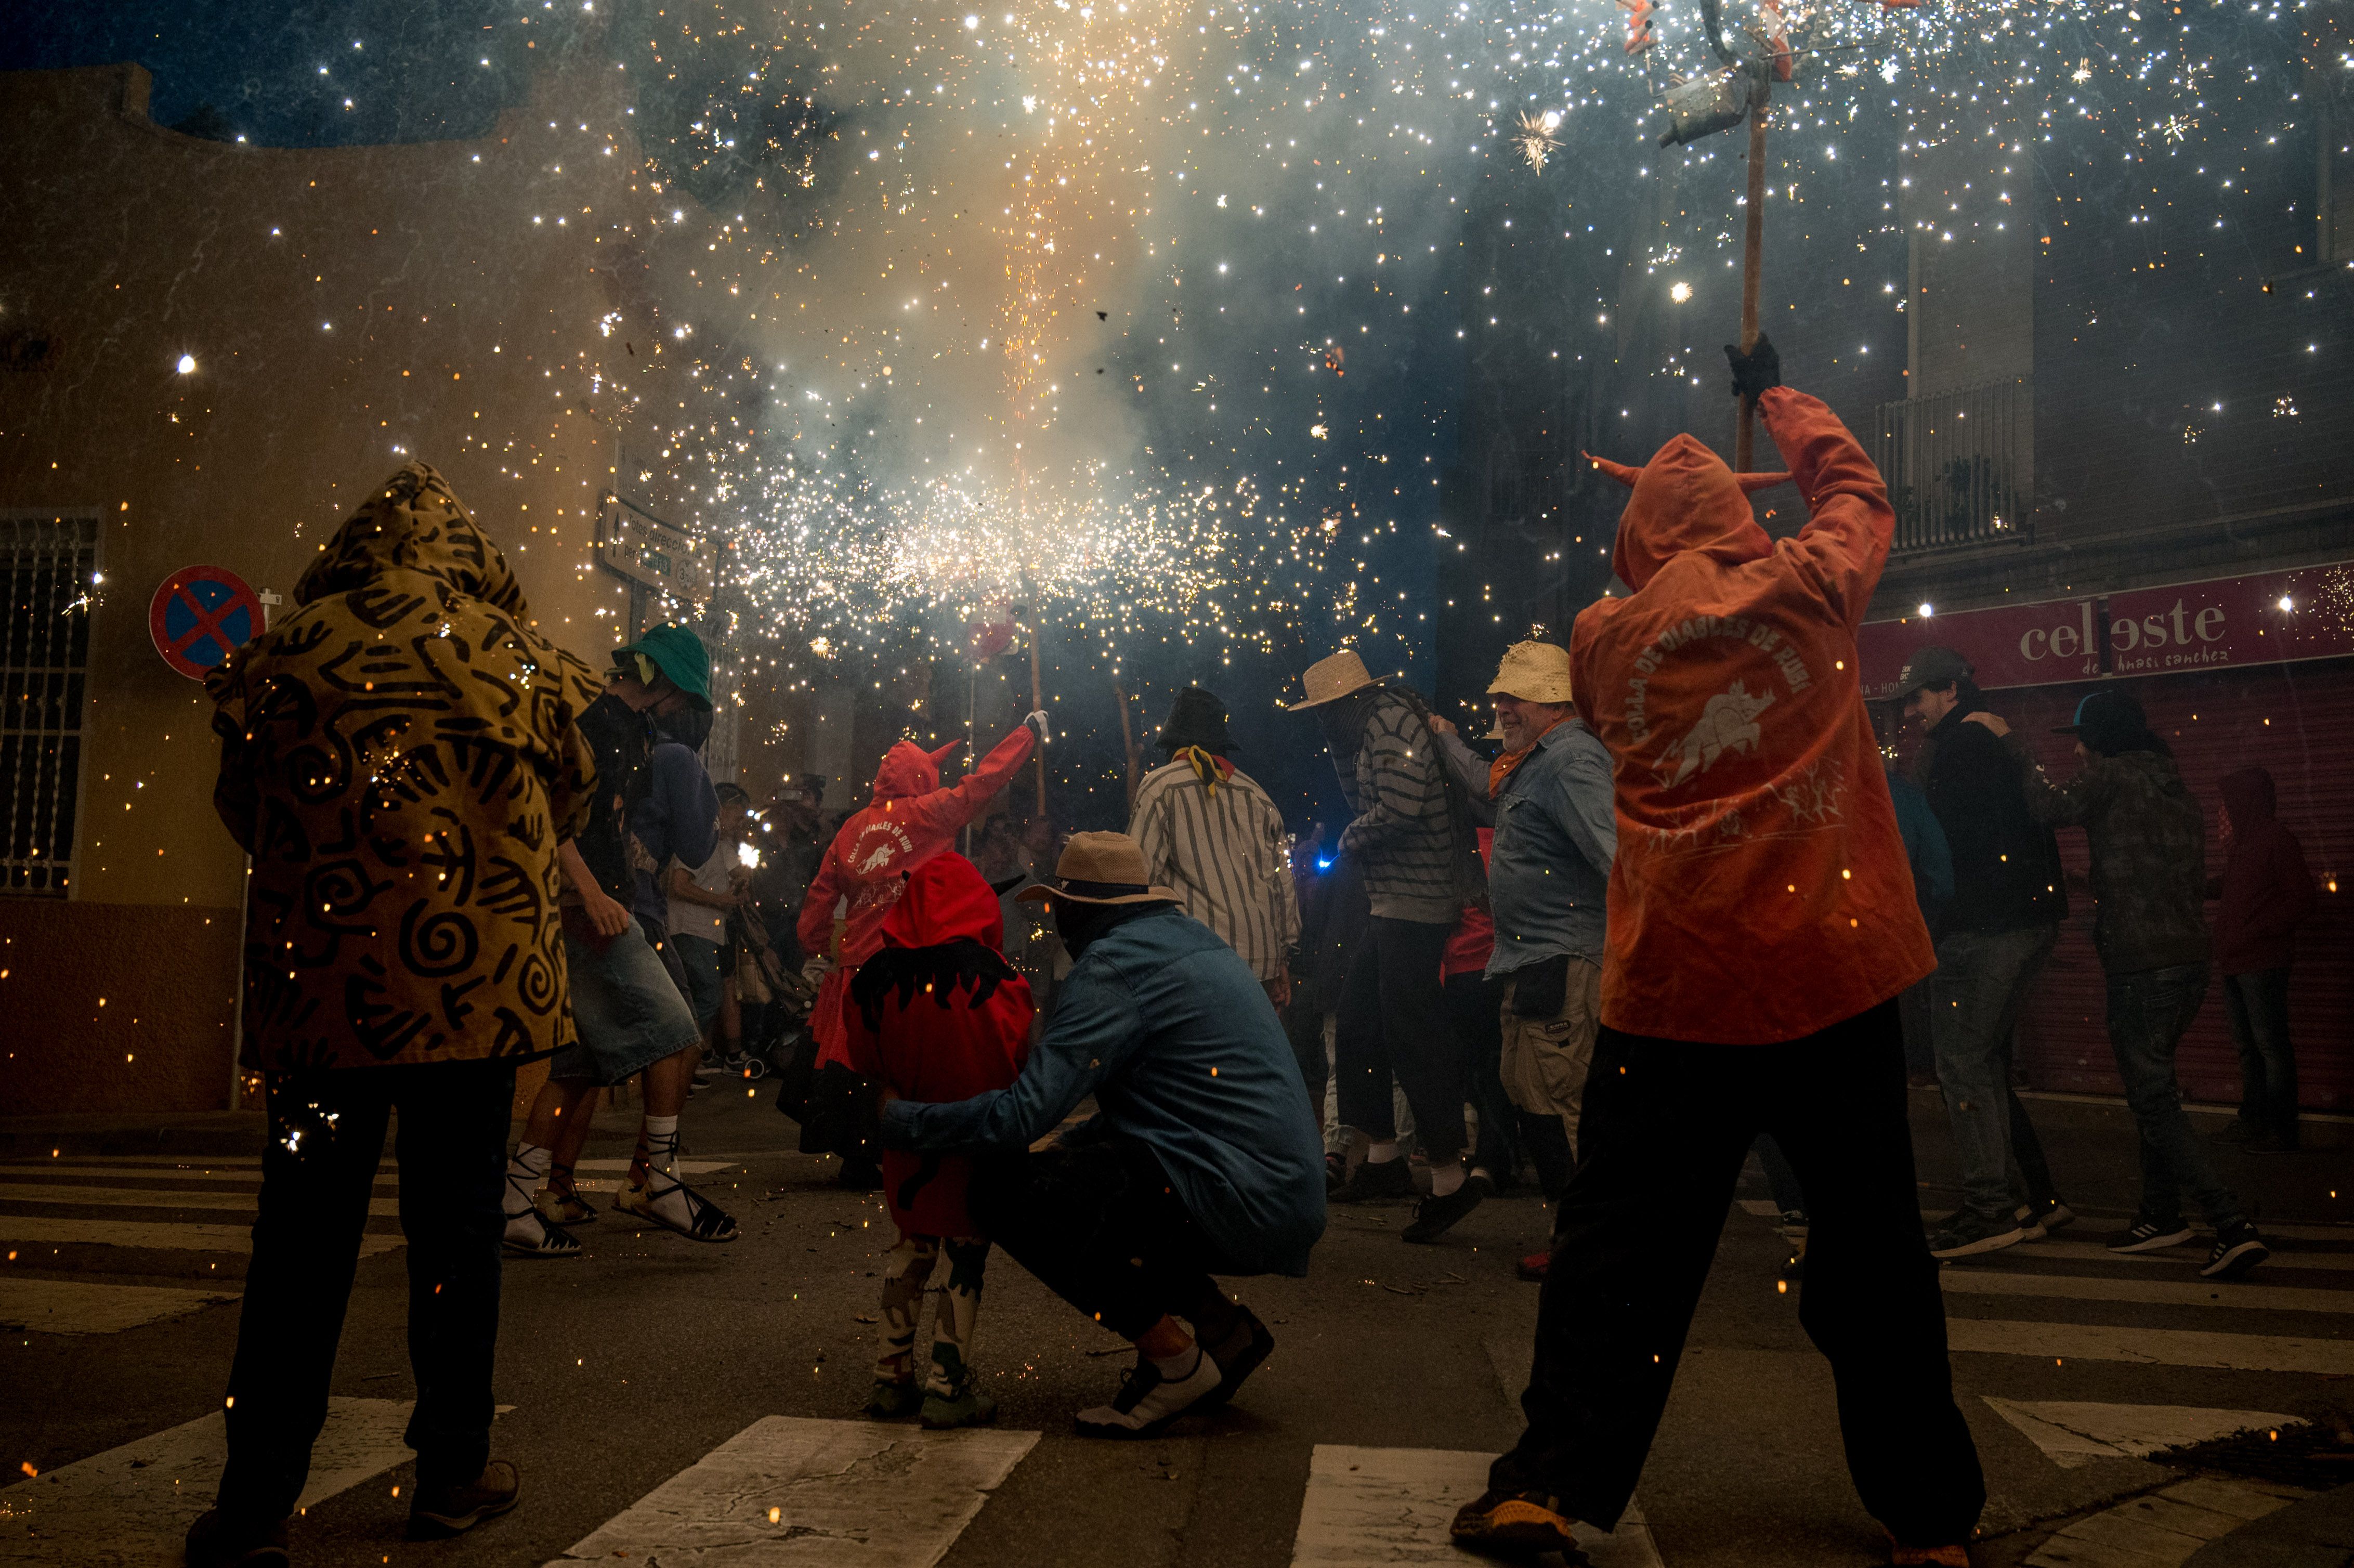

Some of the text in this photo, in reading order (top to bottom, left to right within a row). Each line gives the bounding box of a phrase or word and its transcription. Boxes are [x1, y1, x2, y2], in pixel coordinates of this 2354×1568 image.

[628, 513, 648, 537] Totes
[624, 544, 636, 559] per
[1658, 616, 1750, 651] DIABLES
[1748, 624, 1782, 652] DE
[2020, 598, 2226, 660] celeste
[1634, 645, 1663, 674] DE
[2082, 657, 2099, 675] de
[2165, 645, 2229, 665] sanchez
[1625, 677, 1650, 742] COLLA
[847, 842, 860, 863] COLLA
[866, 821, 893, 834] DIABLES
[892, 825, 903, 837] DE
[898, 835, 913, 853] RUBI
